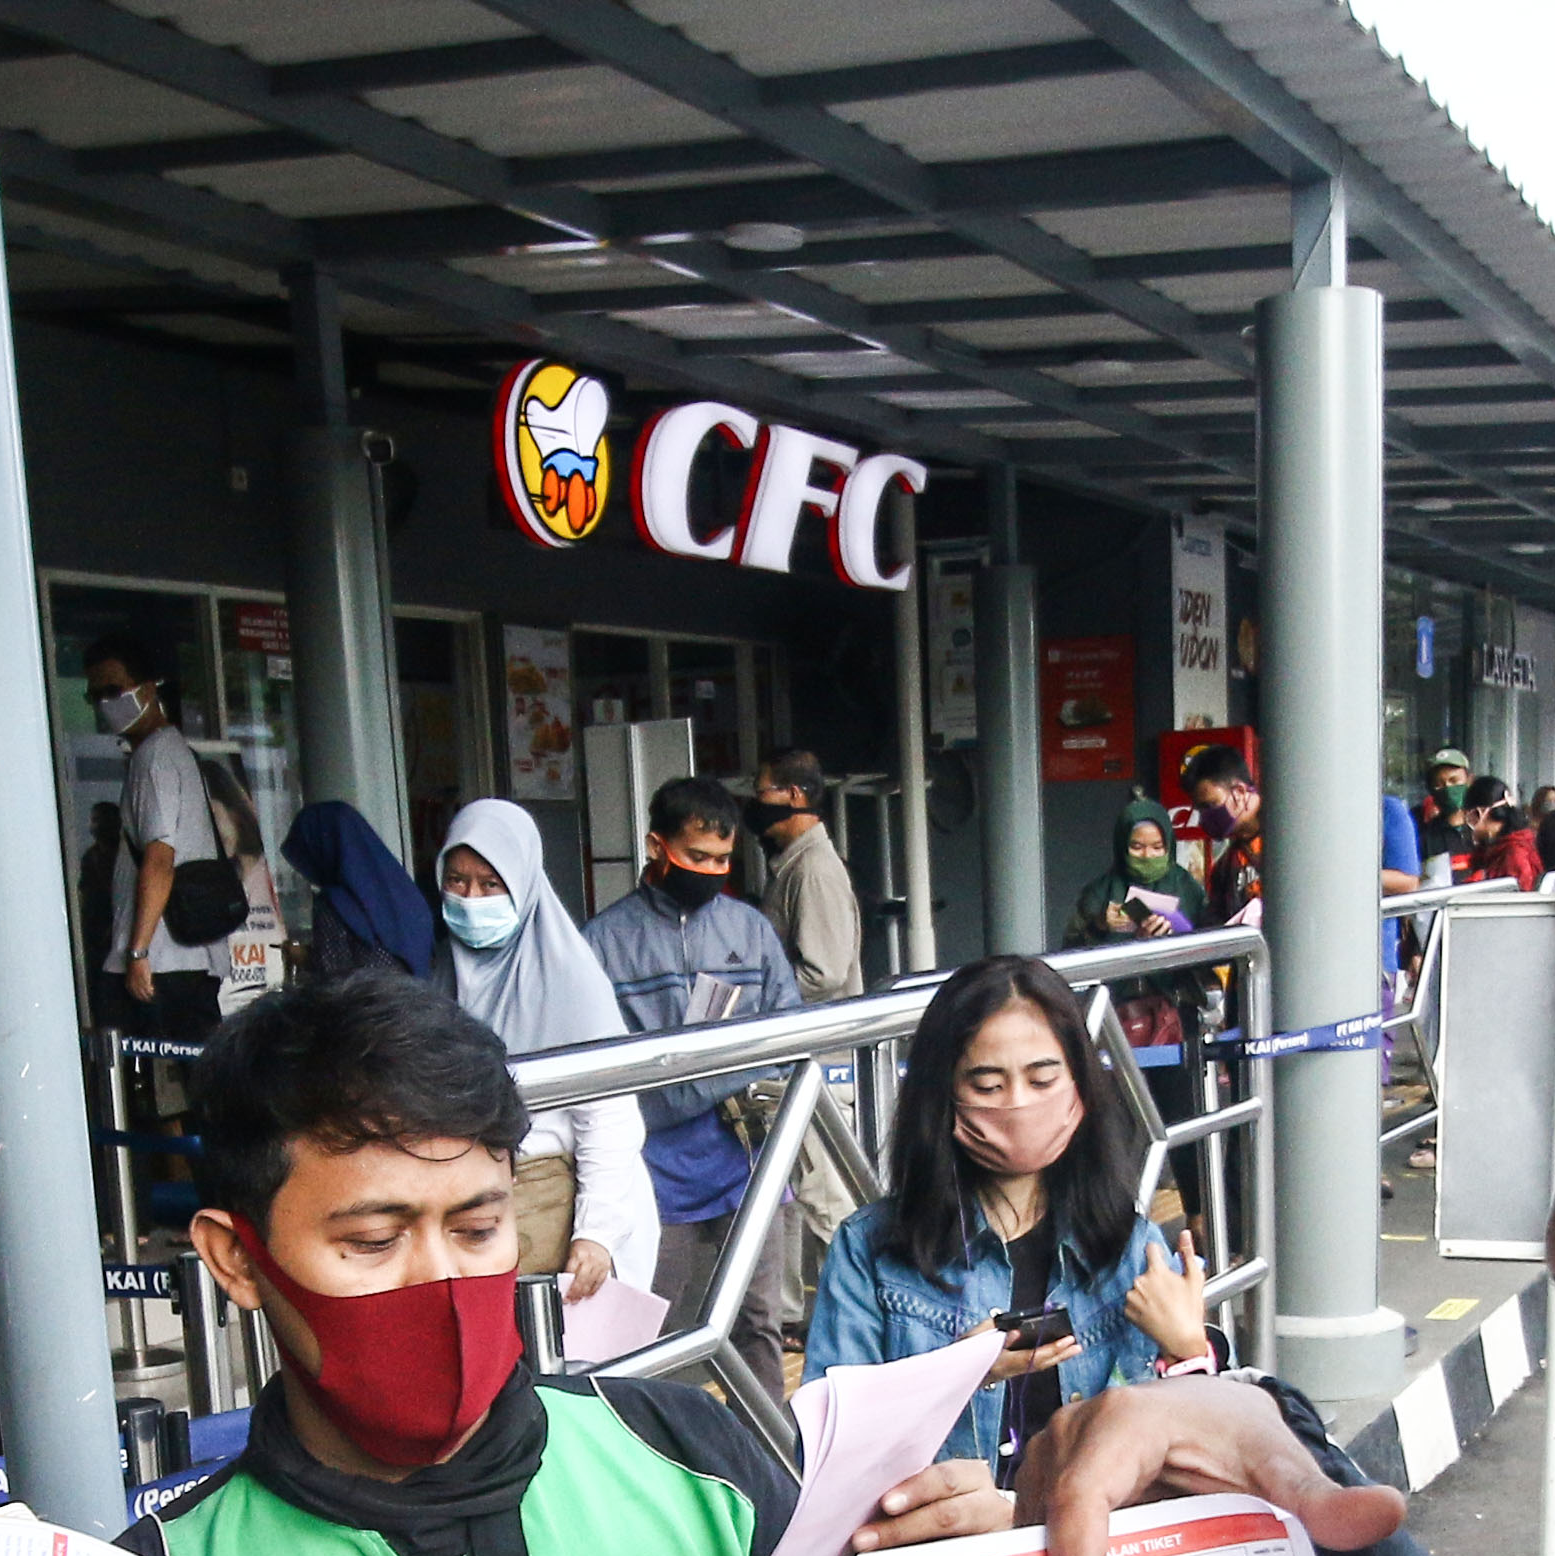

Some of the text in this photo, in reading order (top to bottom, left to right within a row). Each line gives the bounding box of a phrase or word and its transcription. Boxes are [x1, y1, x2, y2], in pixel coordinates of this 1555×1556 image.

[629, 401, 927, 591] CFC
[1482, 642, 1538, 693] LAWSON
[233, 943, 266, 966] KAI
[132, 1039, 156, 1054] KAI
[159, 1042, 204, 1057] (Perse
[1244, 1040, 1271, 1055] KAI
[1272, 1032, 1309, 1053] (Persero)
[828, 1068, 850, 1081] PT
[106, 1270, 146, 1291] KAI
[1141, 1533, 1183, 1553] TIKET
